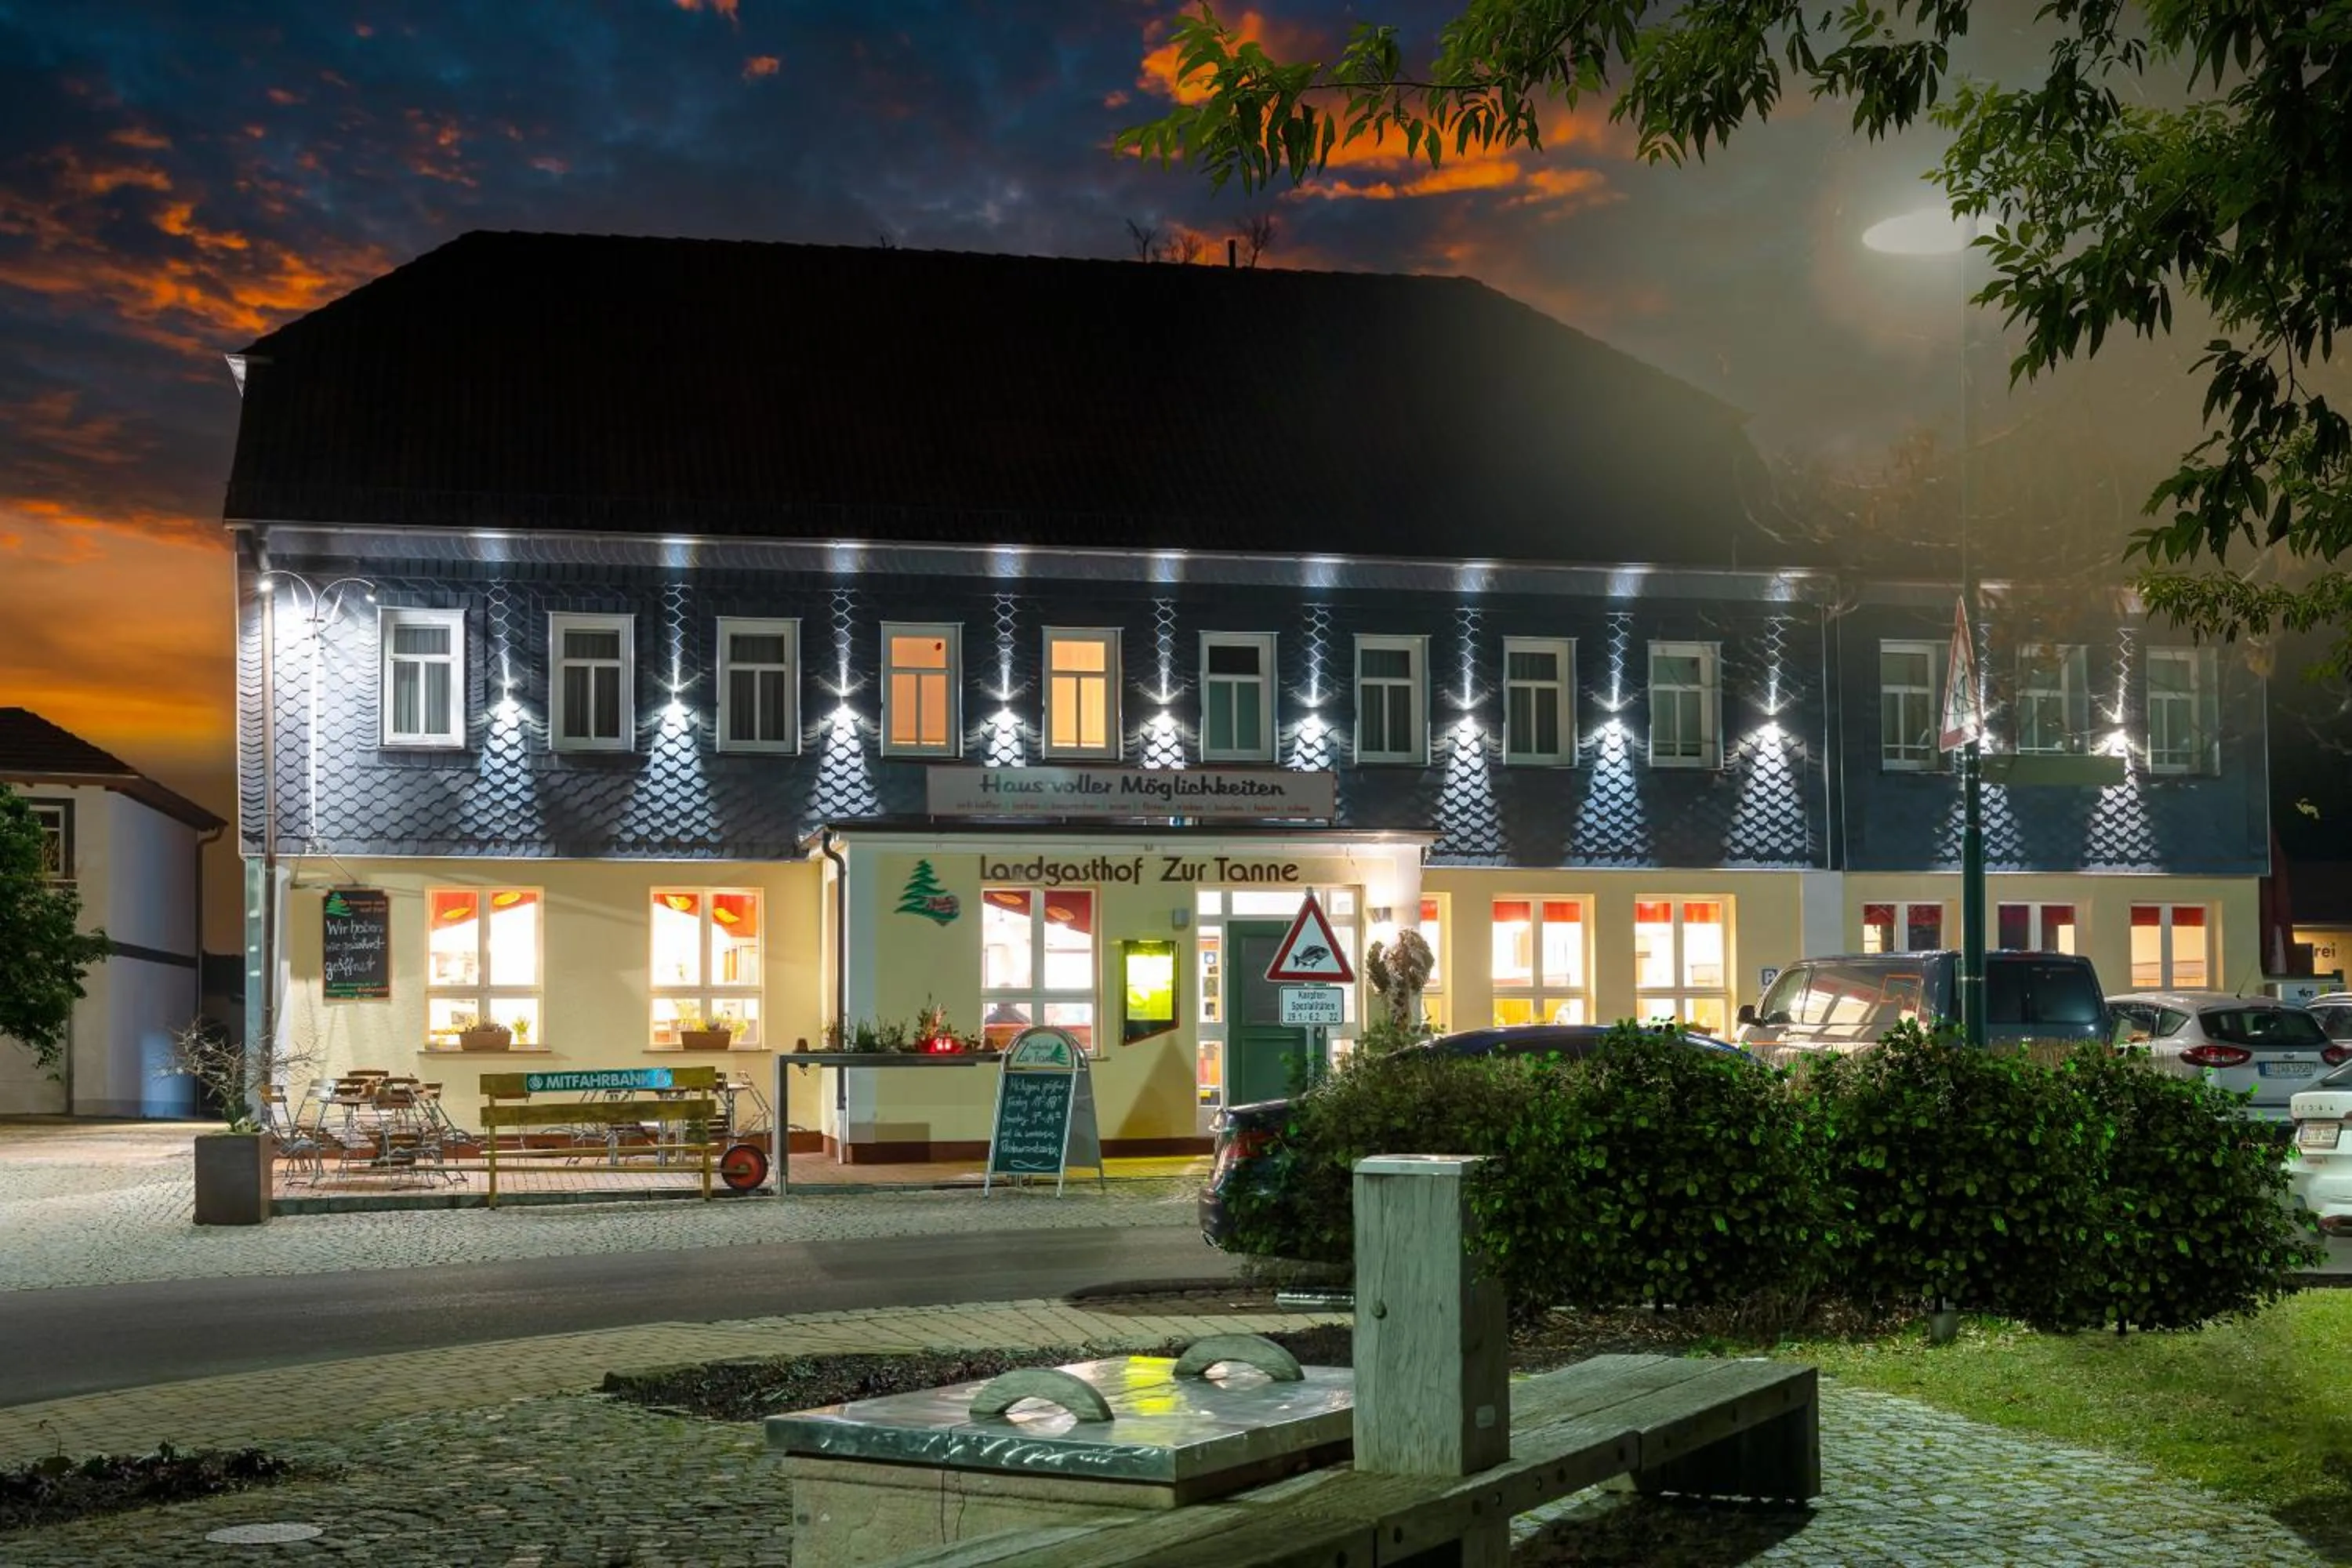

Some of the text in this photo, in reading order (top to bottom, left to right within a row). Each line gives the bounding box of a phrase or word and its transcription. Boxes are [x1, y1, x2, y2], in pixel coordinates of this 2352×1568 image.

[980, 773, 1286, 801] Haus voller Möglichkeiten
[980, 855, 1299, 887] Landgasthof Zur Tanne
[326, 918, 348, 935] Wir
[546, 1071, 650, 1089] MITFAHRBANK
